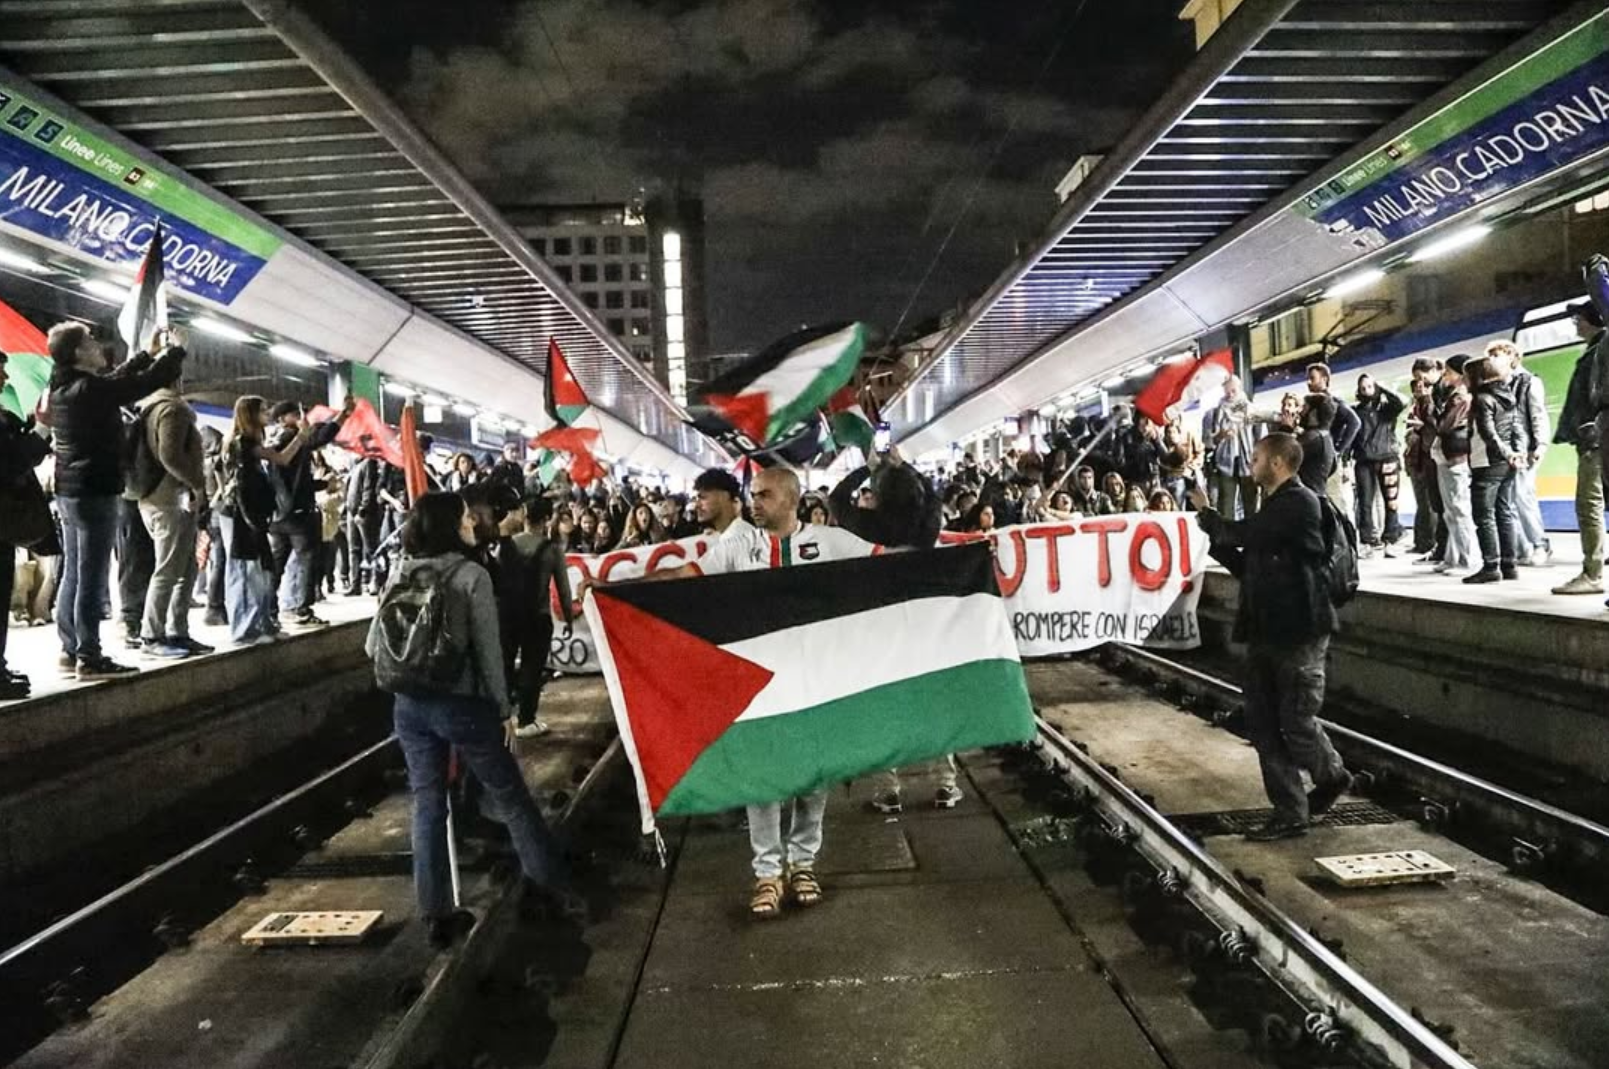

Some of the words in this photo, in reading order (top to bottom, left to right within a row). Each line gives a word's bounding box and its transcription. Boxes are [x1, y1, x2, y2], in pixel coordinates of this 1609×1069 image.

[61, 134, 96, 161] Linee
[1362, 166, 1461, 229] MILANO
[1456, 85, 1609, 180] CADORNA
[0, 165, 130, 242] MILANO
[125, 222, 237, 288] CDORNA
[939, 516, 1194, 599] UTTO!
[1013, 609, 1092, 643] ROMPERE
[1094, 611, 1127, 640] CON
[1133, 611, 1198, 643] ISRAELE
